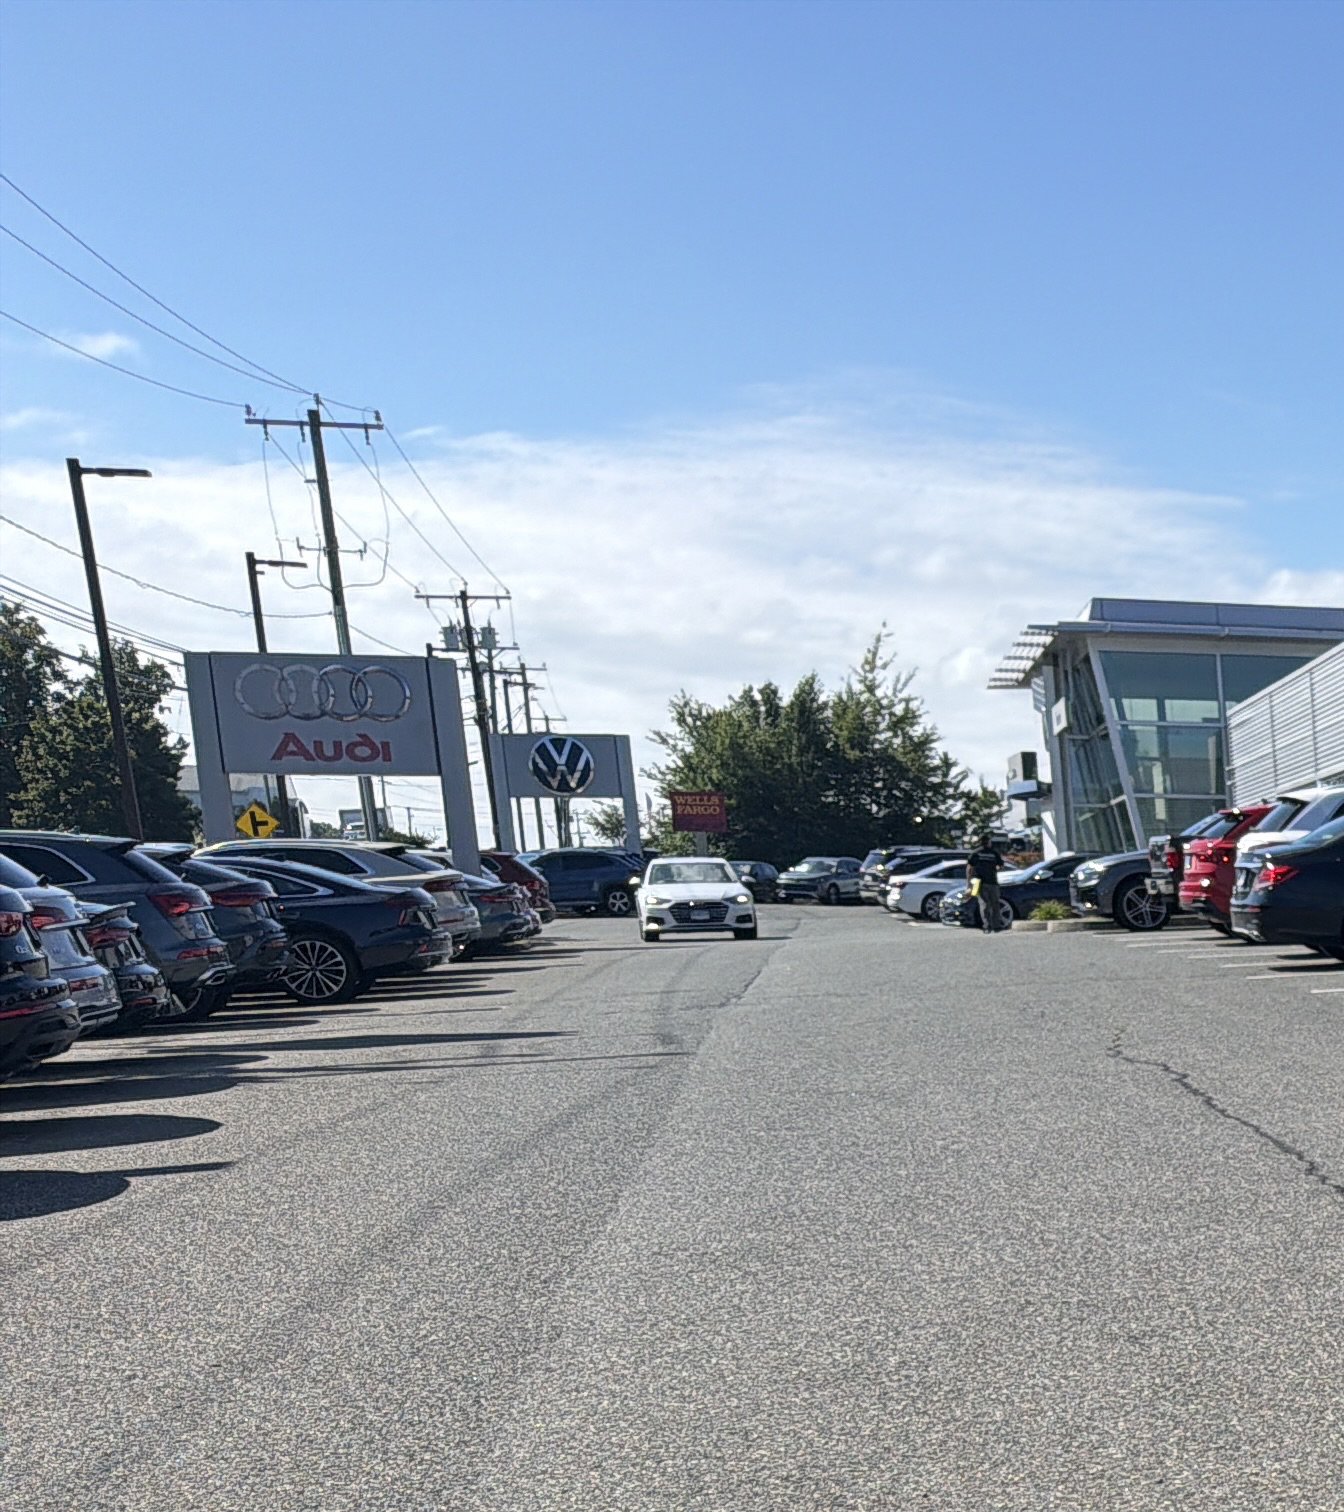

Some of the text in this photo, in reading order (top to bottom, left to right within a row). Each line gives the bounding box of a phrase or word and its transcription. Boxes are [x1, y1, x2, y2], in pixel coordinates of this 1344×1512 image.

[271, 732, 392, 763] Audi
[673, 795, 720, 805] WELLS
[676, 805, 721, 815] FARGO
